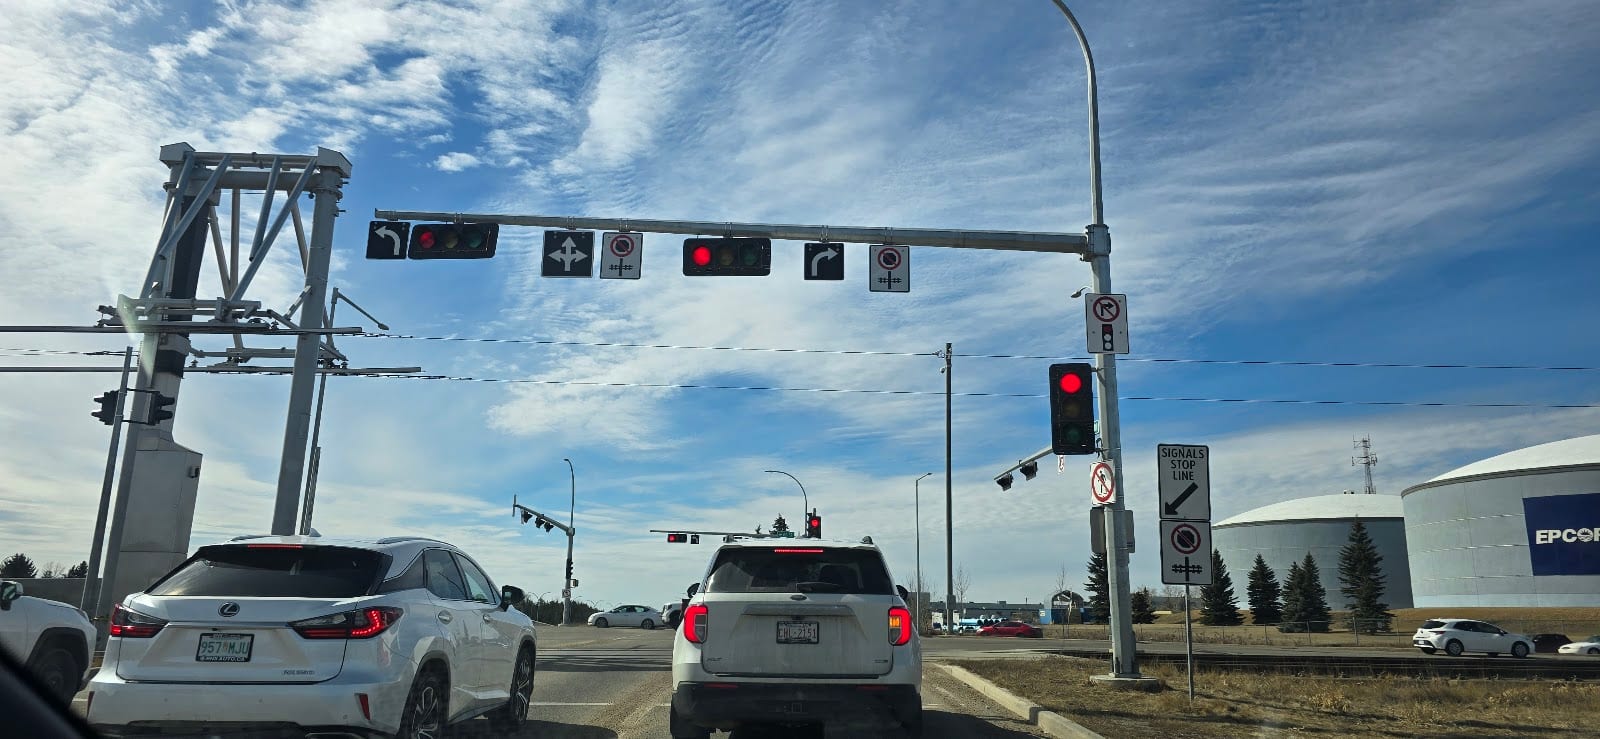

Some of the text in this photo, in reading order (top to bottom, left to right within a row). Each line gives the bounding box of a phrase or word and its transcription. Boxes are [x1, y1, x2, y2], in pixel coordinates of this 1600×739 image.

[1161, 447, 1205, 459] SIGNALS
[1170, 459, 1196, 470] STOP
[1172, 470, 1195, 481] LINE
[200, 641, 250, 655] 957 MJU
